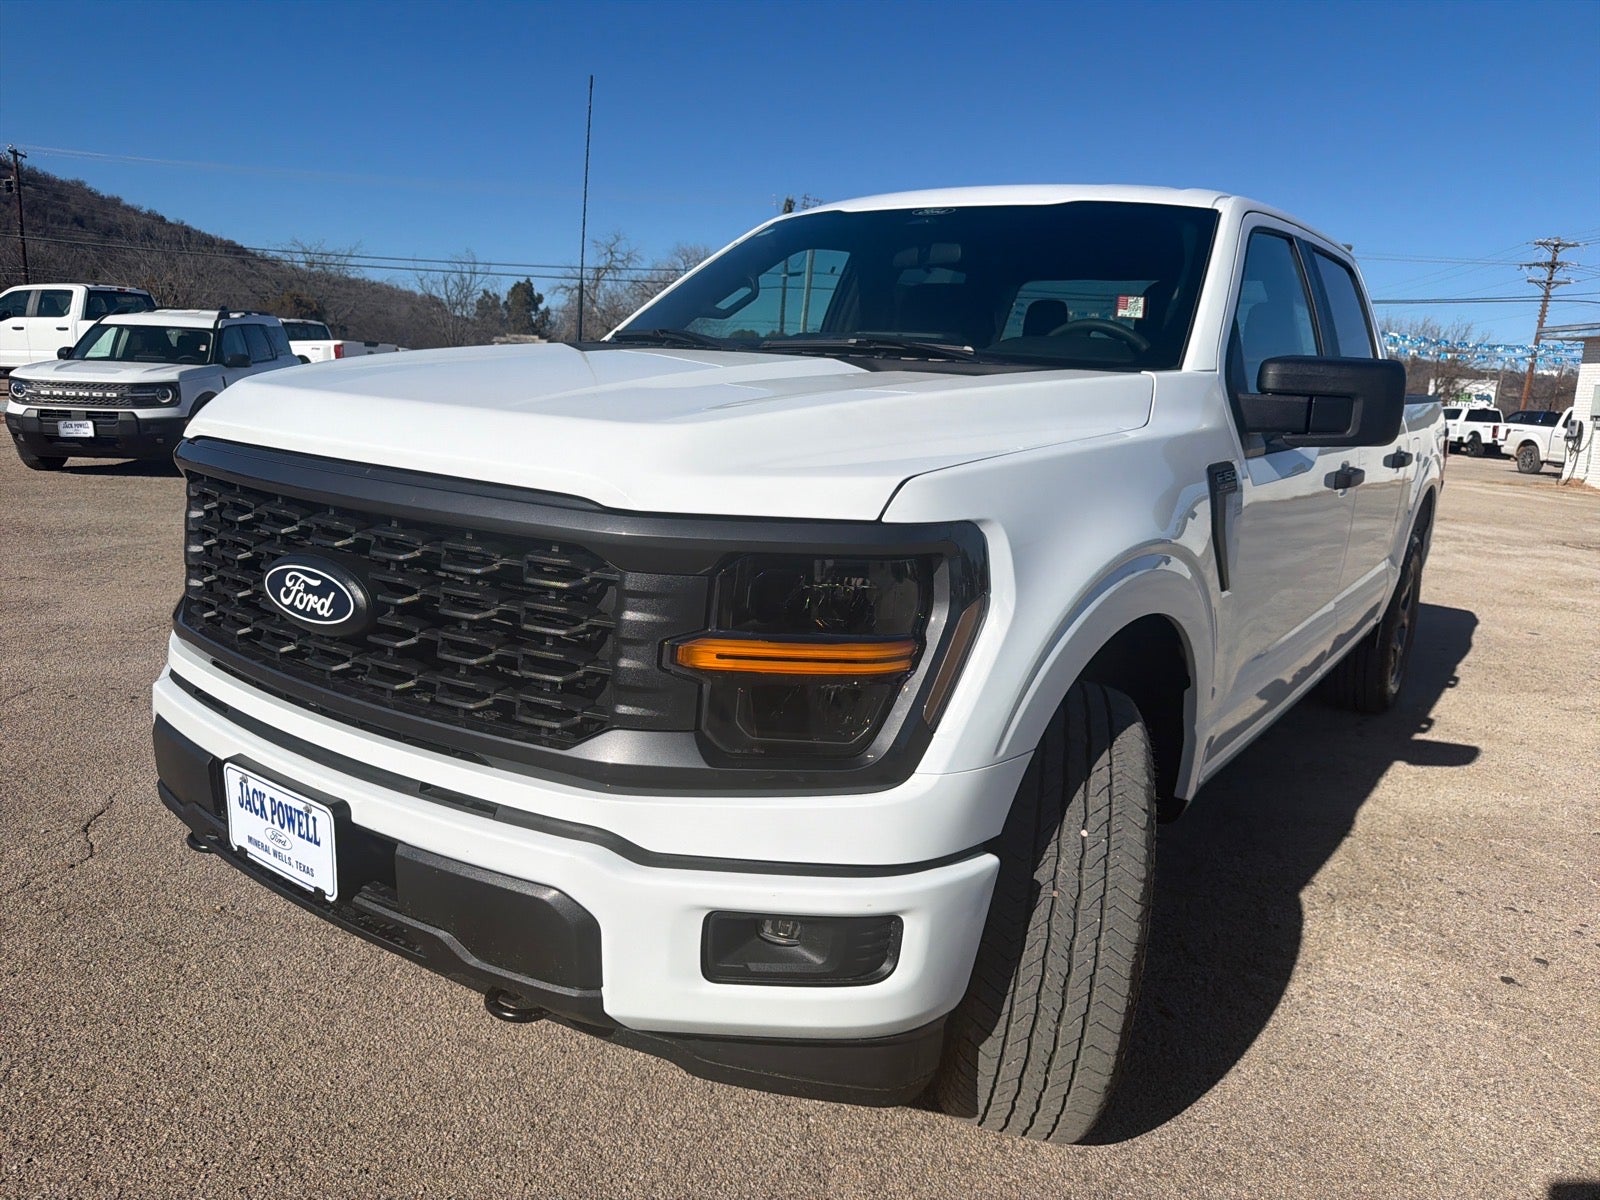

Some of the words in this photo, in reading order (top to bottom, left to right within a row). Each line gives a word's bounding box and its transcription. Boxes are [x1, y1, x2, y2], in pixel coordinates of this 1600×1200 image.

[280, 571, 335, 617] Ford
[238, 782, 268, 821] JACK
[269, 797, 321, 847] POWELL
[247, 835, 271, 855] MINERAL
[295, 860, 314, 878] TEXAS
[269, 830, 287, 847] Ford
